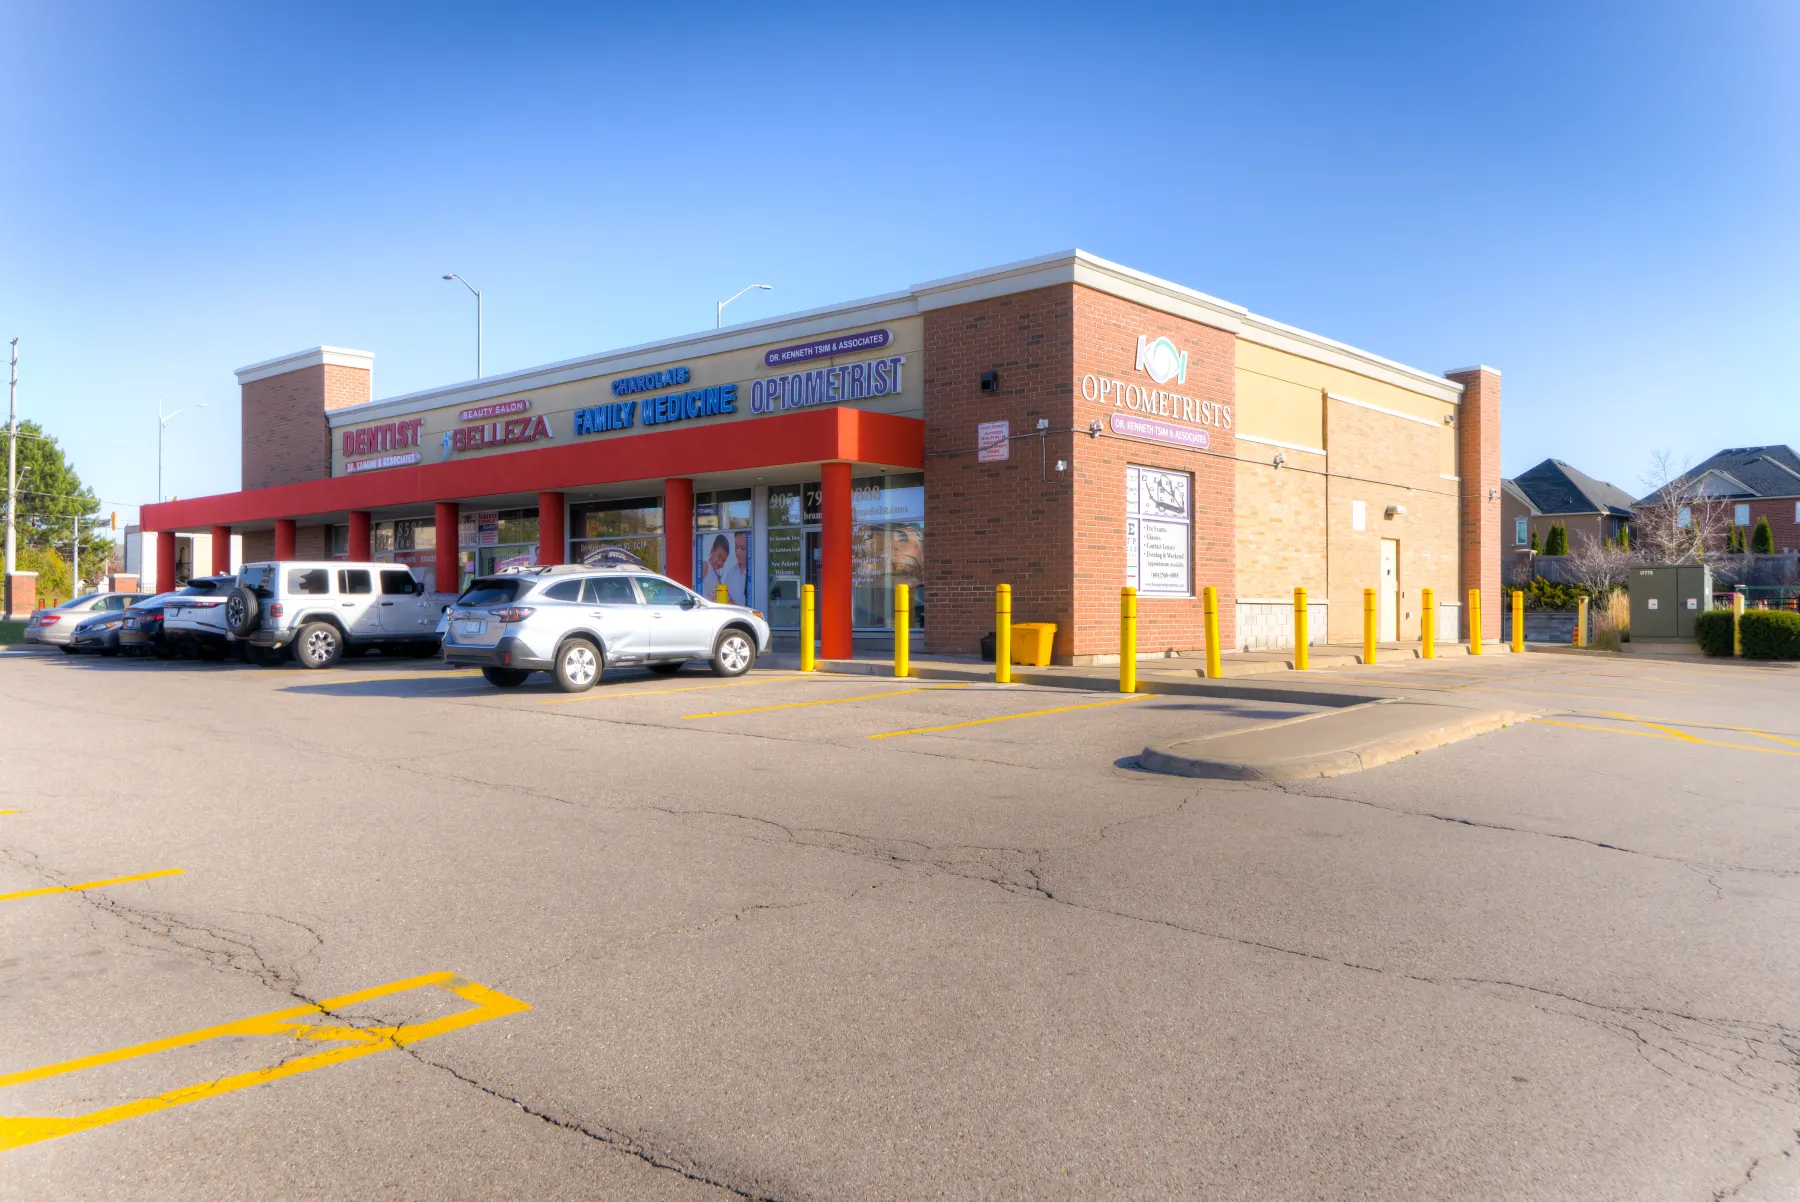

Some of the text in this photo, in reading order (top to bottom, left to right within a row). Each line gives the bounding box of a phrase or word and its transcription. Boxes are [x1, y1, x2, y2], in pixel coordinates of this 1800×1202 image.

[769, 334, 884, 363] DR. KENNETH TSIM & ASSOCIATES
[611, 366, 690, 397] CHAROLAIS
[751, 354, 907, 414] OPTOMETRIST
[463, 401, 524, 420] BEAUTY SALON
[574, 384, 738, 436] FAMILY MEDICINE
[1081, 374, 1232, 429] OPTOMETRISTS
[343, 418, 422, 457] DENTIST
[452, 415, 554, 452] BELLEZA
[1115, 418, 1207, 444] DR. KENNETH TSIM & ASSOCIATES
[383, 453, 416, 467] ASSOCIATES
